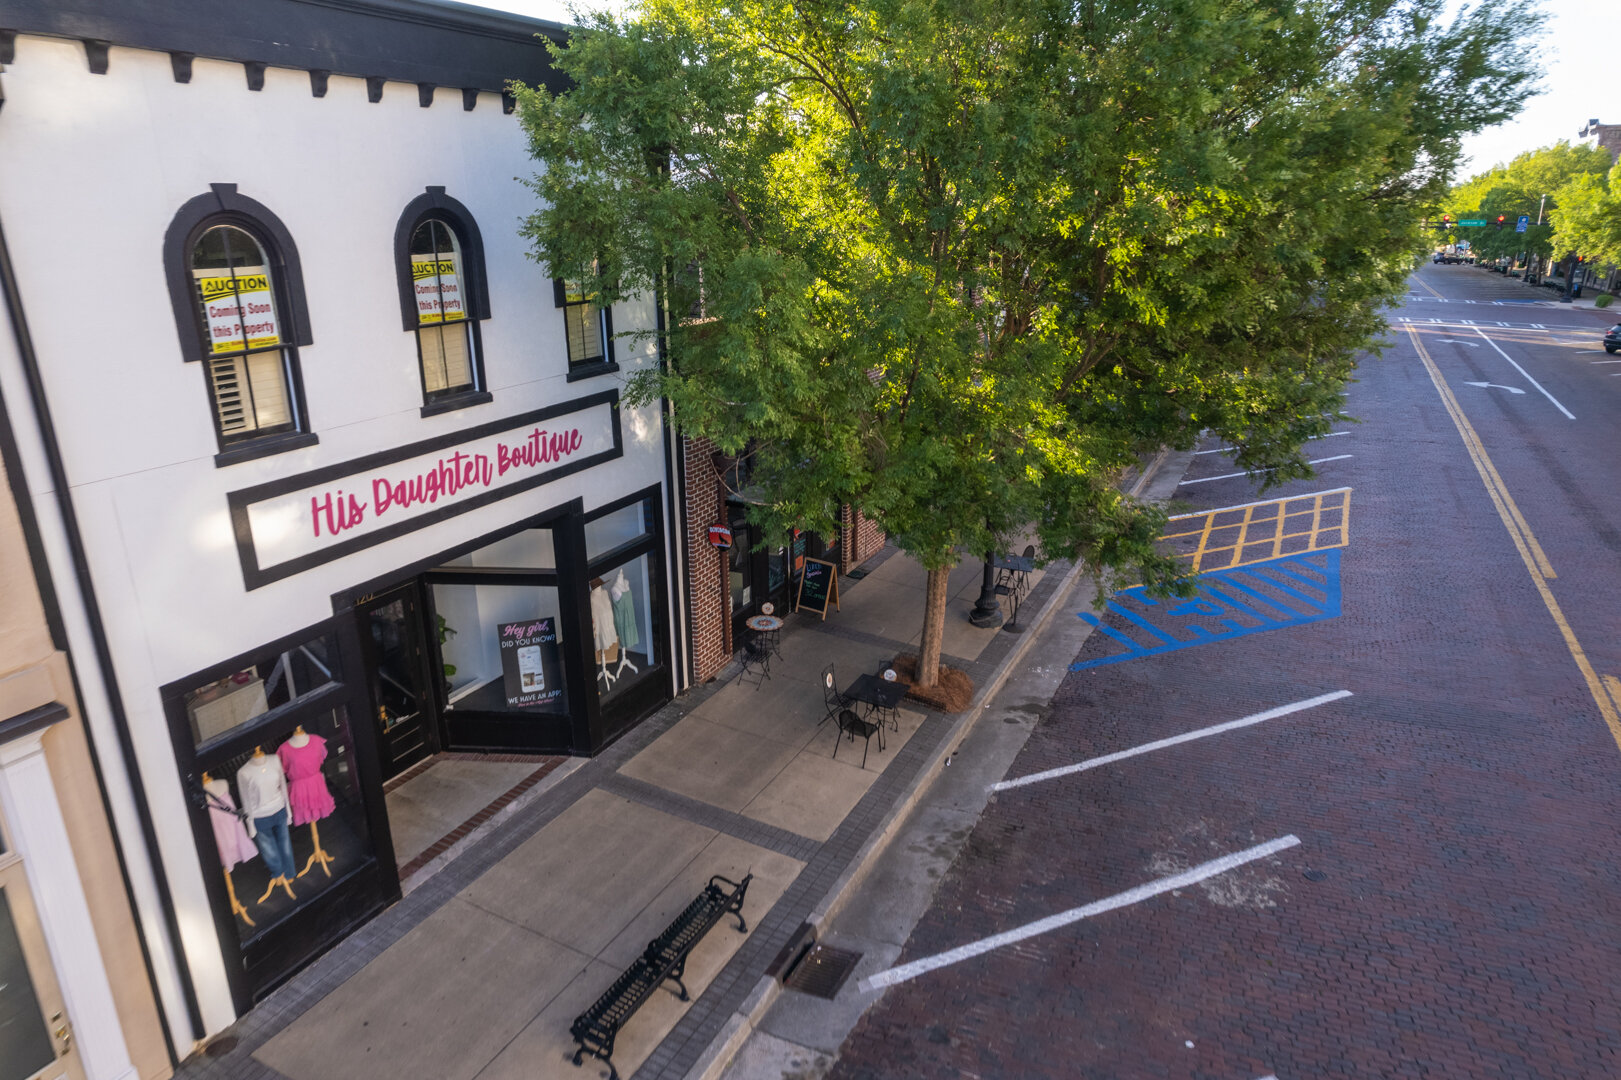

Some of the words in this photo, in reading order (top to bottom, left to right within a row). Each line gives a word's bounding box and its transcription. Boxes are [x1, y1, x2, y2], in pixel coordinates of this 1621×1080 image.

[412, 263, 454, 273] AUCTON
[204, 277, 267, 292] AUCTION
[440, 282, 458, 293] Soon
[247, 302, 272, 315] Soon
[419, 300, 433, 310] this
[433, 299, 461, 311] Prperty
[213, 325, 233, 338] this
[234, 321, 274, 336] Poperty
[311, 491, 367, 537] His
[372, 450, 494, 517] Daughter
[497, 427, 583, 477] Boutique
[504, 624, 525, 639] Hey
[527, 620, 549, 637] girl,
[516, 638, 531, 646] YOU
[533, 634, 555, 643] KNOW?
[520, 694, 536, 702] HAVE
